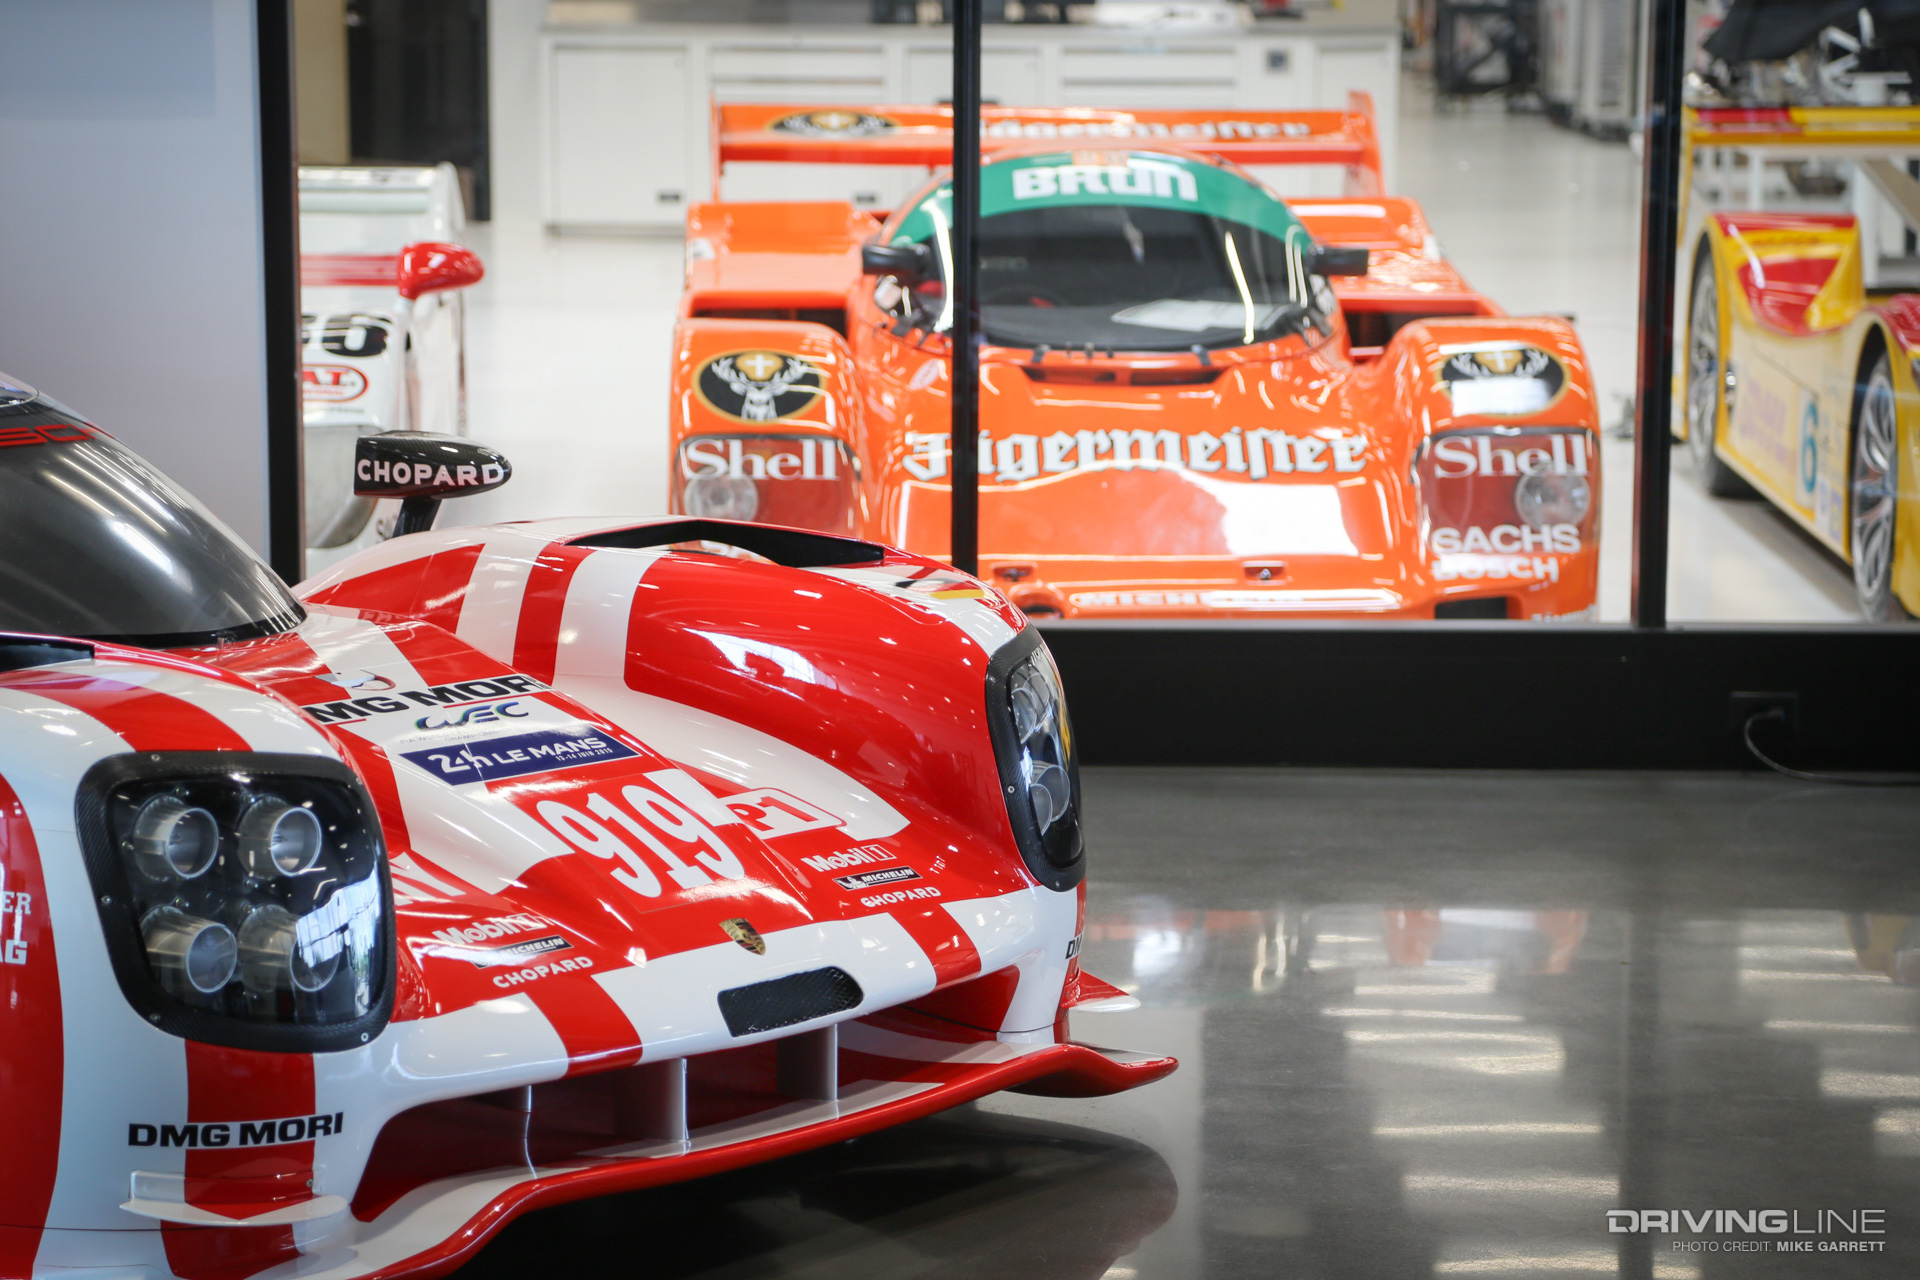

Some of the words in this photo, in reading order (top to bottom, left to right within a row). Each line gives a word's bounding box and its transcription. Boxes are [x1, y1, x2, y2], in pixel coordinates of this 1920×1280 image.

[684, 439, 839, 480] Shell
[1433, 434, 1590, 479] Shell
[357, 459, 504, 486] CHOPARD
[1431, 523, 1582, 554] SACHS
[303, 697, 410, 723] MG
[415, 702, 529, 730] WEC
[491, 749, 531, 765] LE
[528, 737, 607, 759] MANS
[725, 796, 821, 832] P1
[536, 784, 745, 898] 919
[801, 848, 876, 873] Mobil
[861, 868, 915, 882] MICHELIN
[860, 886, 941, 907] CHOPARD
[432, 919, 521, 946] Mobil
[492, 956, 594, 988] CHOPARD
[128, 1122, 230, 1148] DMG
[239, 1112, 344, 1146] MORI
